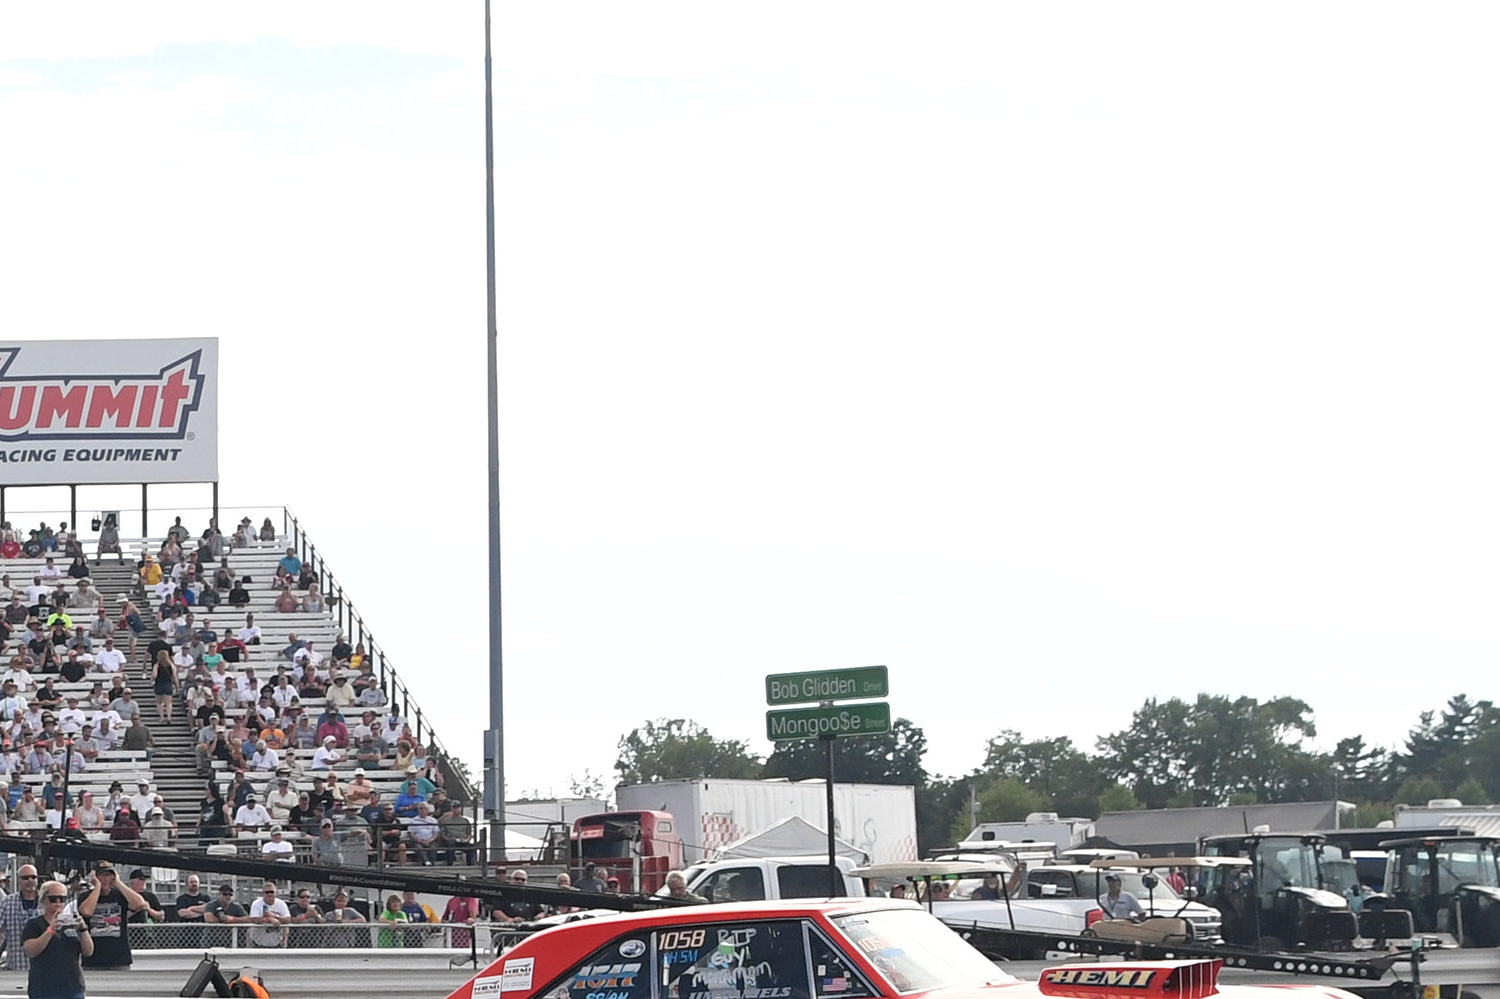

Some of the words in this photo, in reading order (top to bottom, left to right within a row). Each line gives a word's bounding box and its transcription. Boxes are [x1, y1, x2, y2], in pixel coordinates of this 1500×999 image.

[63, 448, 182, 462] EQUIPMENT
[771, 681, 799, 700] Bob
[802, 677, 856, 697] Glidden
[771, 711, 861, 737] Mongoo$e
[658, 929, 706, 951] 1058
[505, 967, 531, 975] HEMI
[1046, 970, 1157, 988] HEMI
[474, 984, 500, 992] HEMI
